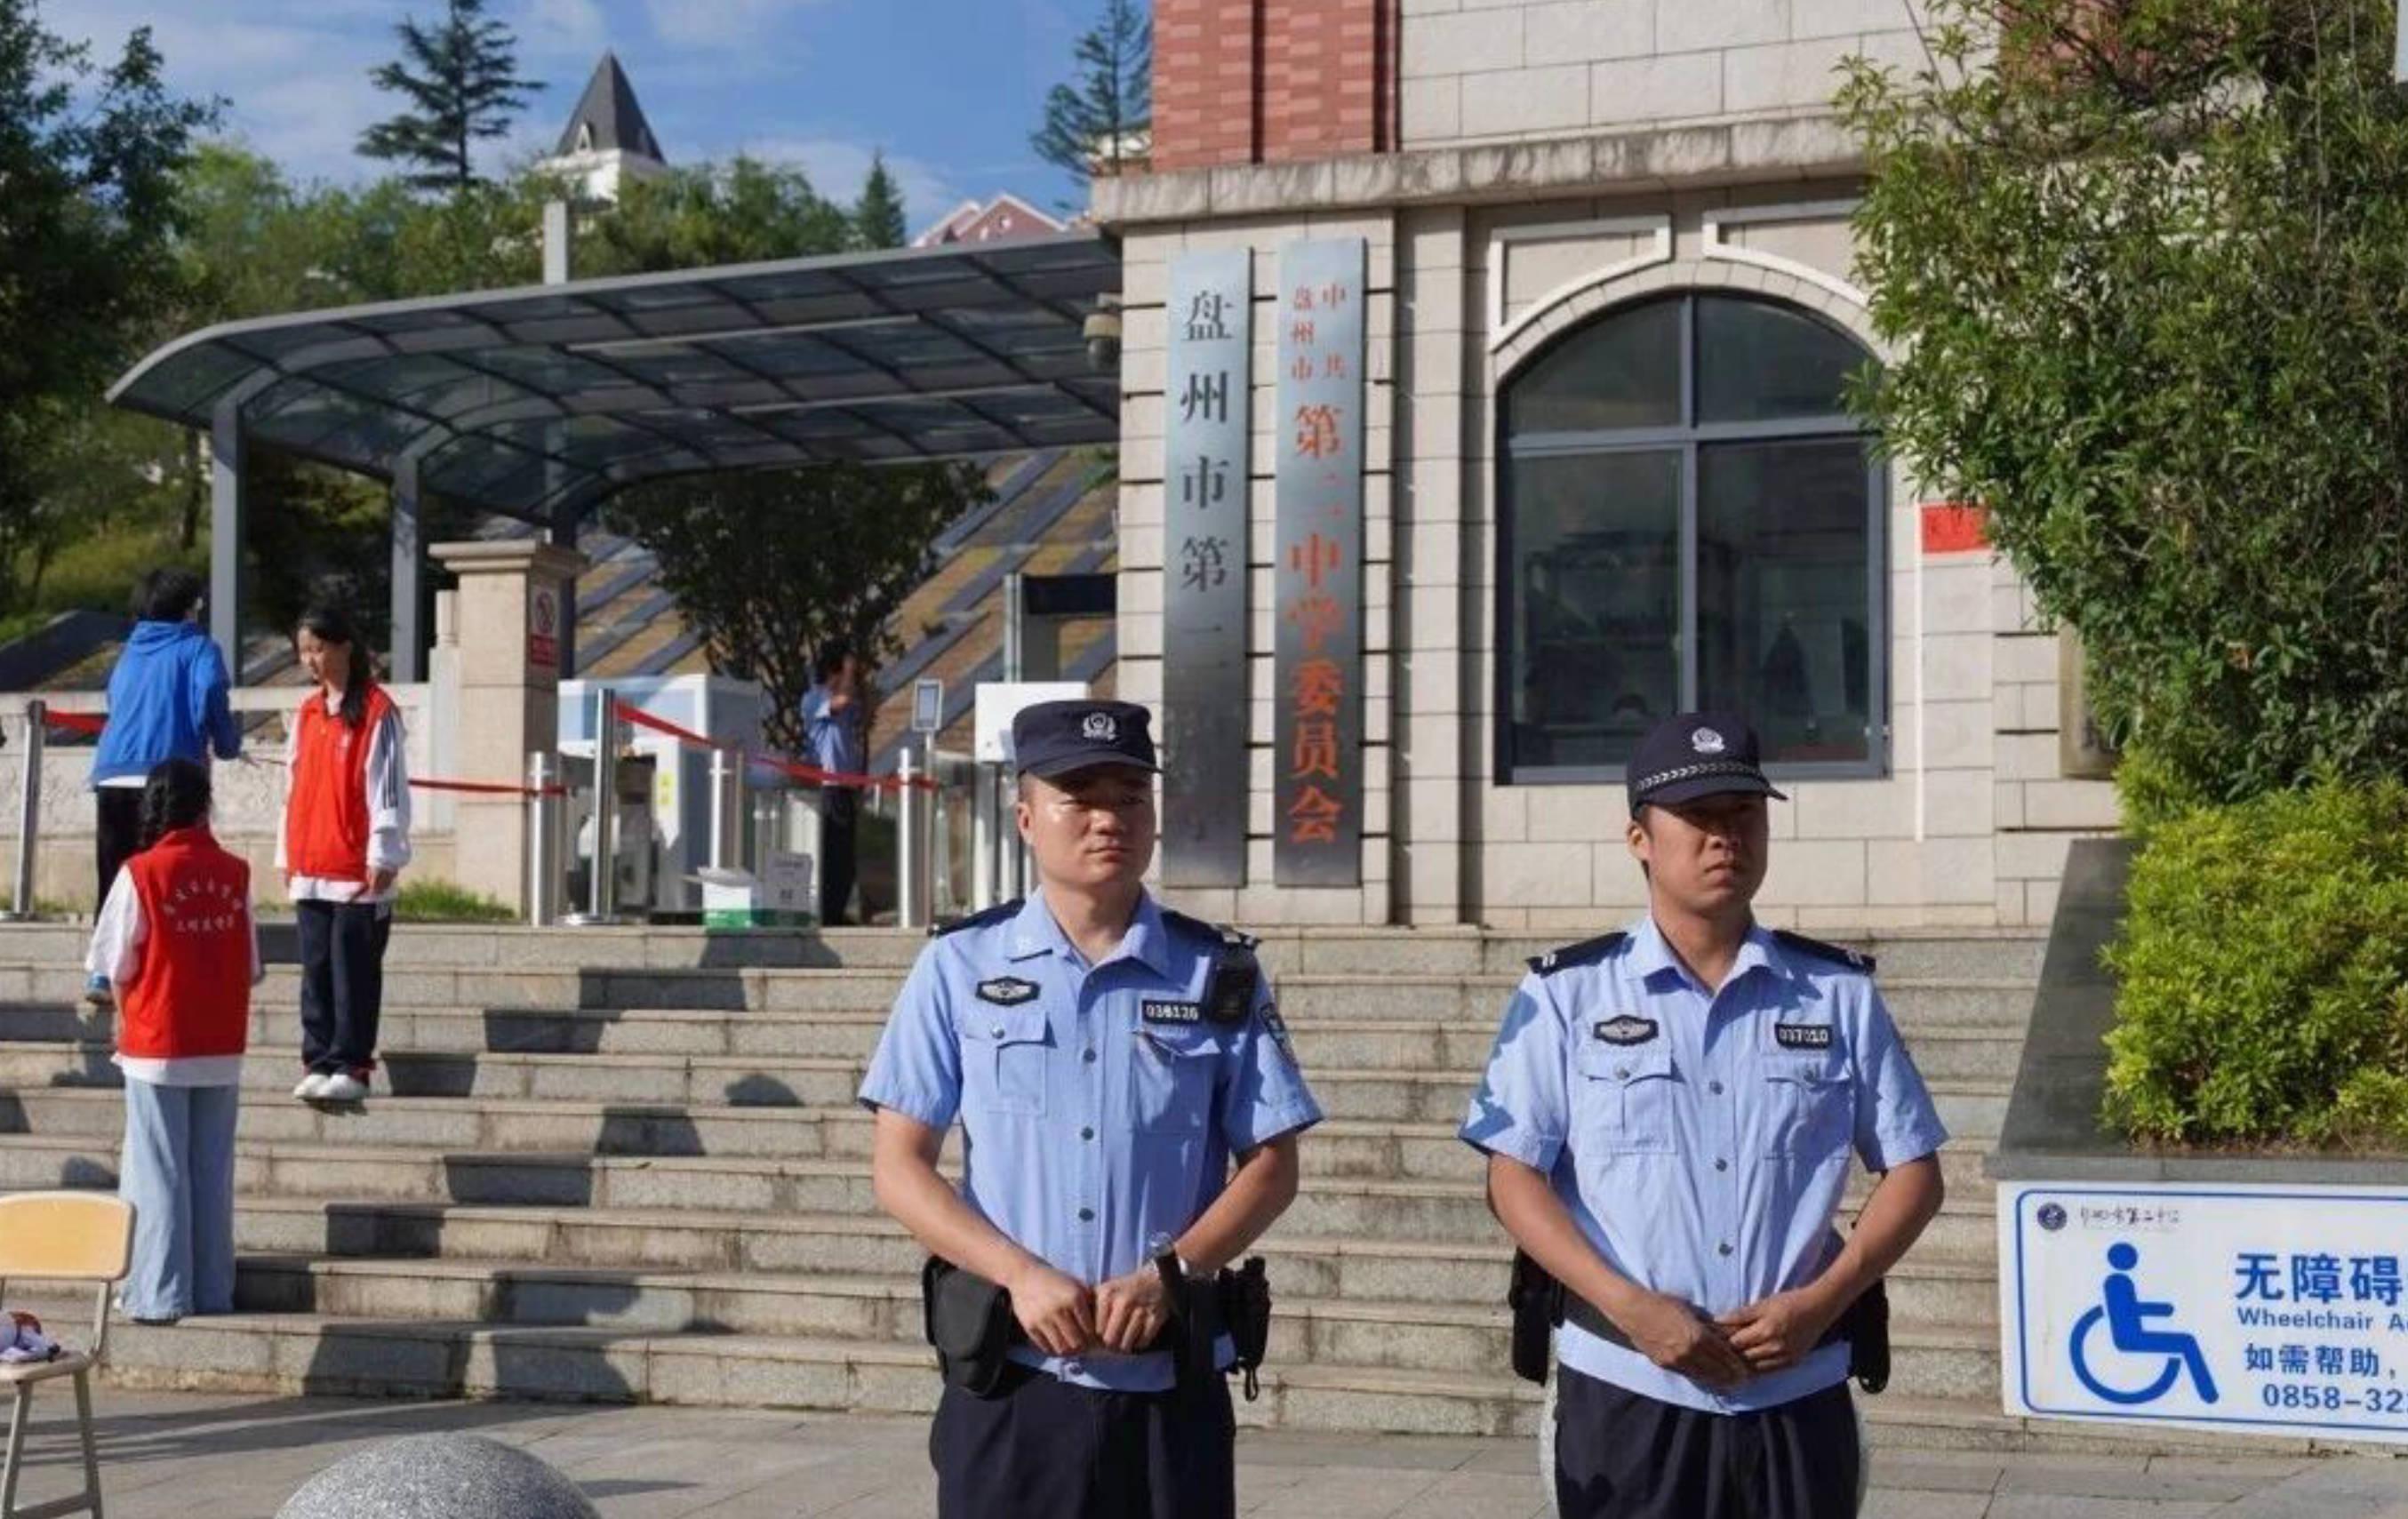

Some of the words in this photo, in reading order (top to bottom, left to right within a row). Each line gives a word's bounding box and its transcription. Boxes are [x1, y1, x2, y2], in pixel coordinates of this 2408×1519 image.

[1290, 284, 1316, 383] 盘州市
[1322, 282, 1347, 380] 中共
[2235, 1252, 2403, 1307] 无障碍
[2236, 1307, 2374, 1331] Wheelchair
[2388, 1314, 2408, 1333] A
[2262, 1383, 2408, 1414] 0858-32
